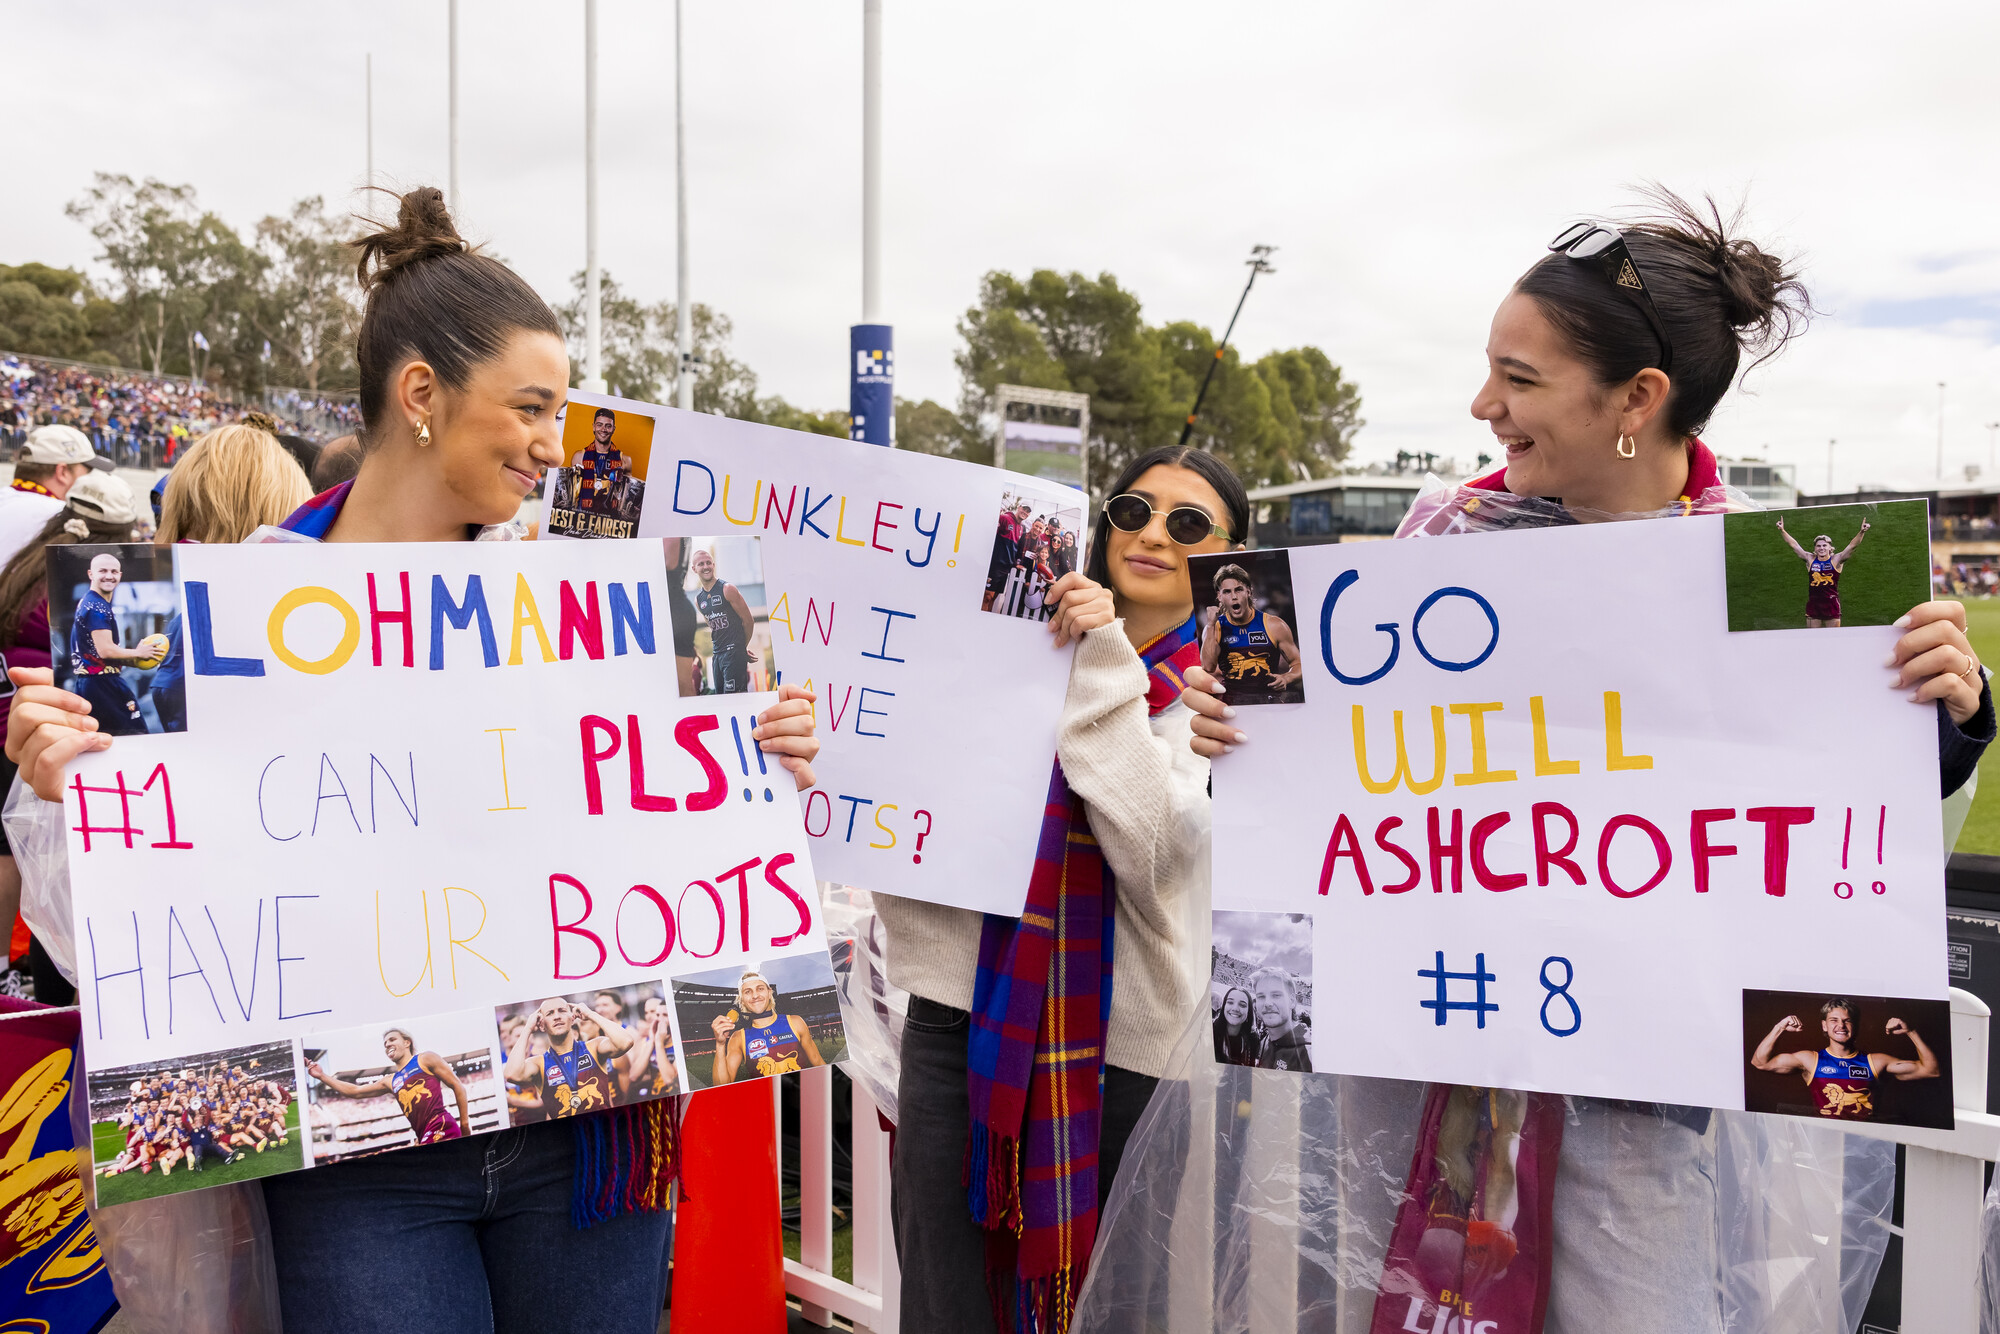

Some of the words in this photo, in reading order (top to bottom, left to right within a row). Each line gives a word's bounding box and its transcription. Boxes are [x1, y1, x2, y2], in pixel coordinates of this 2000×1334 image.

[588, 515, 634, 539] FAIREST
[673, 460, 964, 567] DUNKLEY!
[184, 571, 656, 677] LOHMANN
[770, 592, 834, 646] AN
[862, 607, 916, 663] I
[1250, 633, 1265, 642] youi
[1320, 570, 1499, 686] GO
[777, 671, 895, 738] AVE
[1352, 691, 1653, 795] WILL
[68, 762, 193, 853] #1
[259, 752, 420, 842] CAN
[484, 728, 527, 811] I
[580, 713, 775, 816] PLS!!
[805, 790, 931, 864] OTS?
[1318, 802, 1887, 899] ASHCROFT!!
[86, 895, 332, 1041] HAVE
[376, 887, 511, 997] UR
[549, 853, 812, 980] BOOTS
[1949, 945, 1968, 953] UTION
[1418, 951, 1499, 1029] #
[1540, 956, 1582, 1037] 8
[578, 1058, 590, 1066] oui
